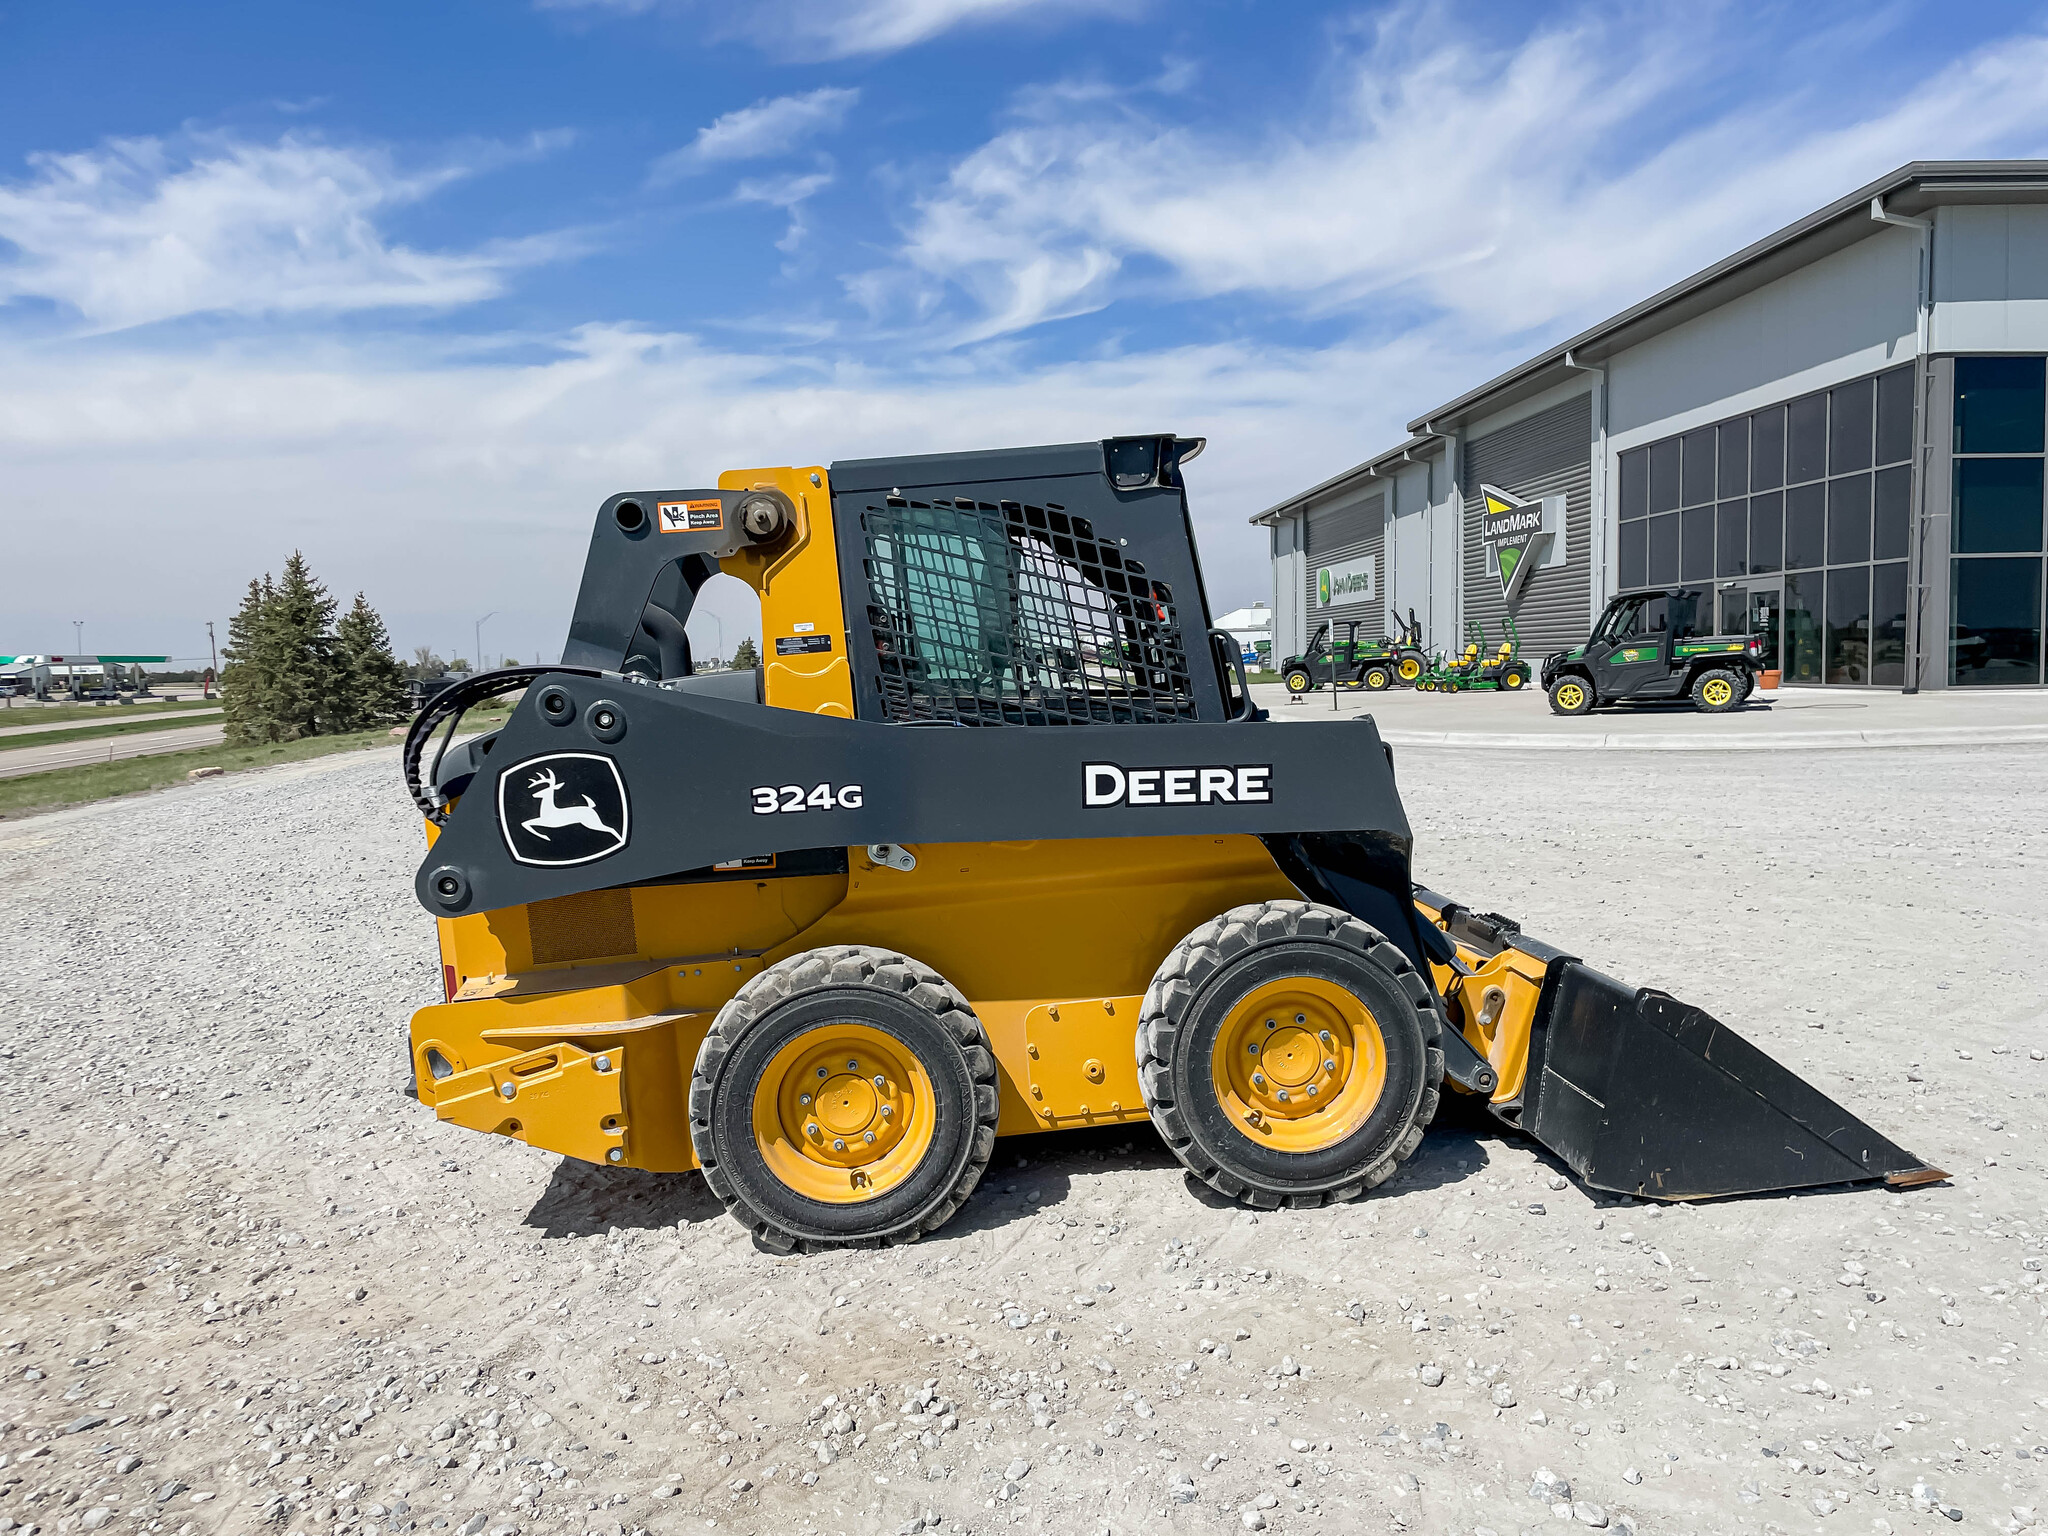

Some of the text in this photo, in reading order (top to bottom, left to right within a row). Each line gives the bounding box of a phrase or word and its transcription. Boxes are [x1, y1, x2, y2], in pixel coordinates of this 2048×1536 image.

[1485, 511, 1541, 537] LANDMARK
[1498, 534, 1528, 547] IMPLEMENT
[751, 782, 863, 815] 324G
[1084, 763, 1271, 807] DEERE
[944, 1040, 972, 1124] GALAXY
